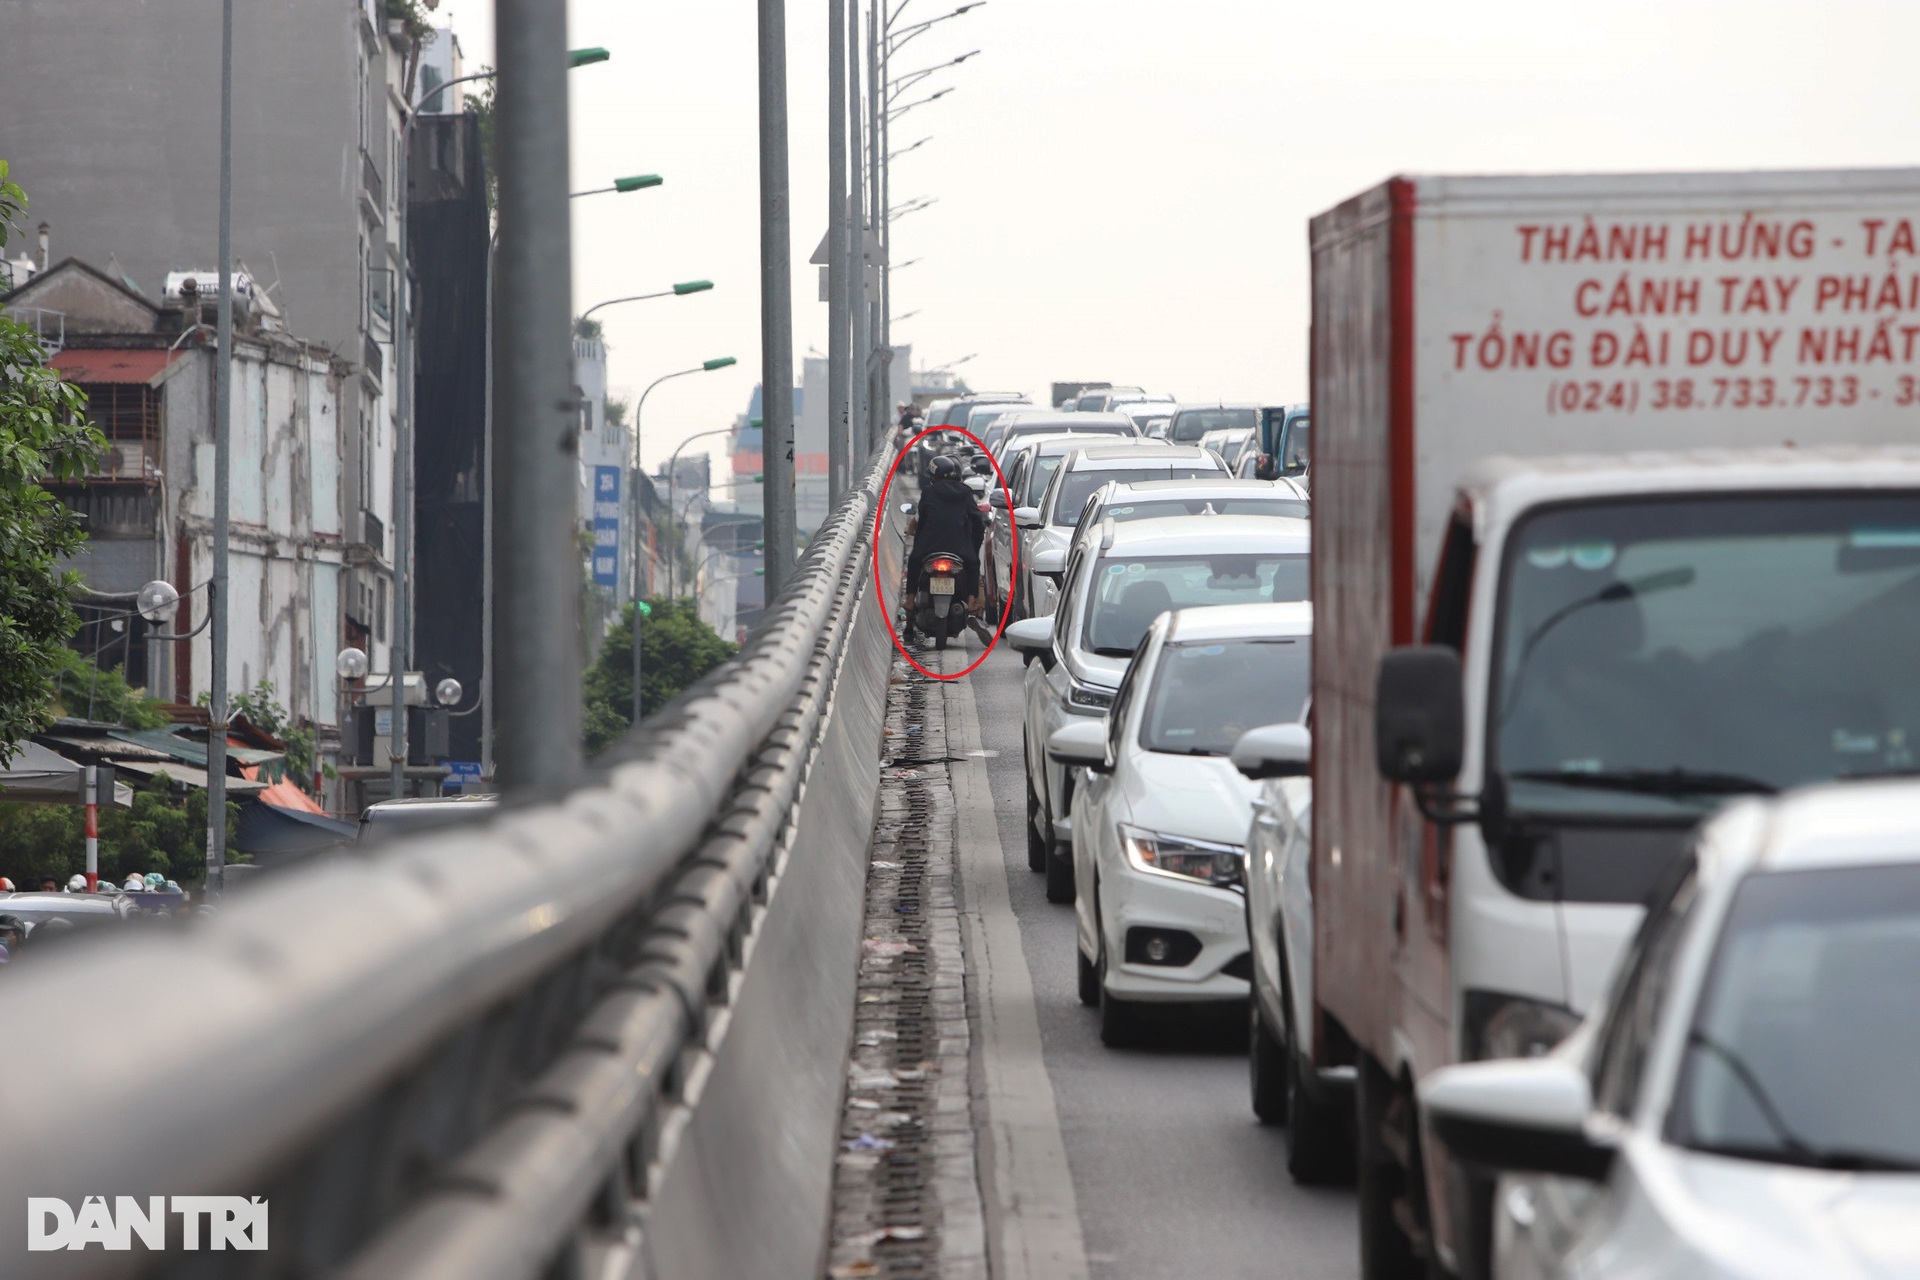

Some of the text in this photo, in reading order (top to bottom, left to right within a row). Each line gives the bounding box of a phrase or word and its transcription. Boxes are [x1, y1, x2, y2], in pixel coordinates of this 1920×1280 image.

[1516, 213, 1669, 261] THÀNH
[1684, 210, 1815, 260] HƯNG
[1861, 219, 1917, 257] TA
[1574, 258, 1920, 318] CÁNH TAY PHẢI
[1450, 309, 1920, 370] TỔNG ĐÀI DUY NHẤT
[1546, 378, 1640, 415] (024)
[1651, 374, 1857, 409] 38.733.733
